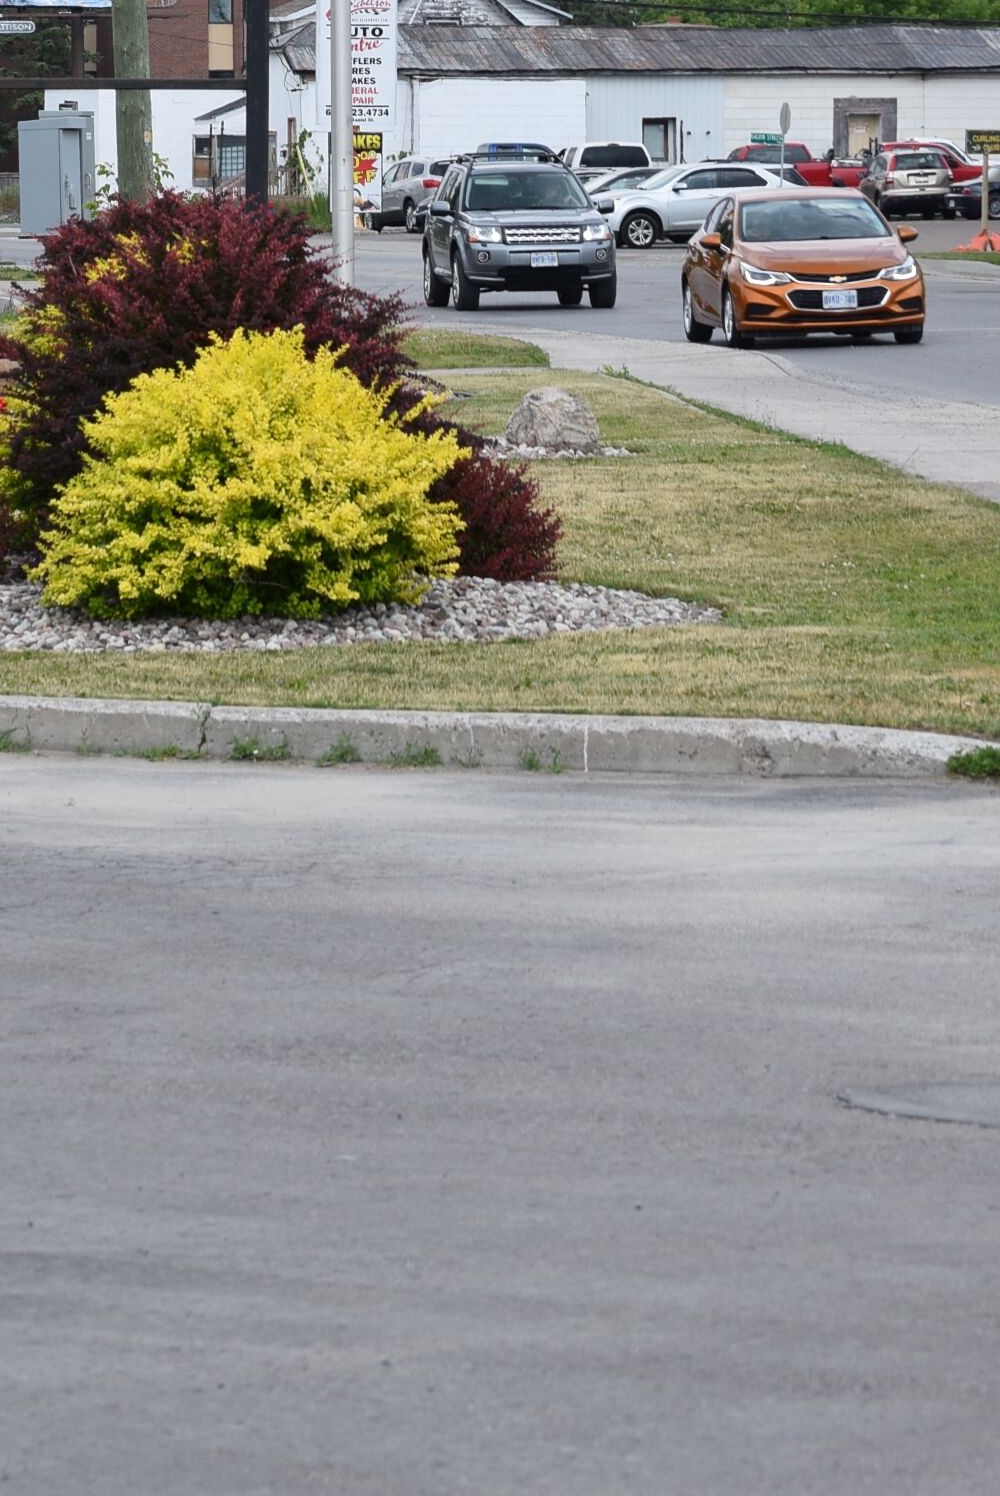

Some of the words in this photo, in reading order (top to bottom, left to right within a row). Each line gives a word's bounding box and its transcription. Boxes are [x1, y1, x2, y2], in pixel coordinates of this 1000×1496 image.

[351, 27, 384, 37] UTO
[351, 37, 382, 52] ntre
[353, 57, 382, 65] FLERS
[352, 67, 371, 75] RES
[353, 169, 376, 184] FF
